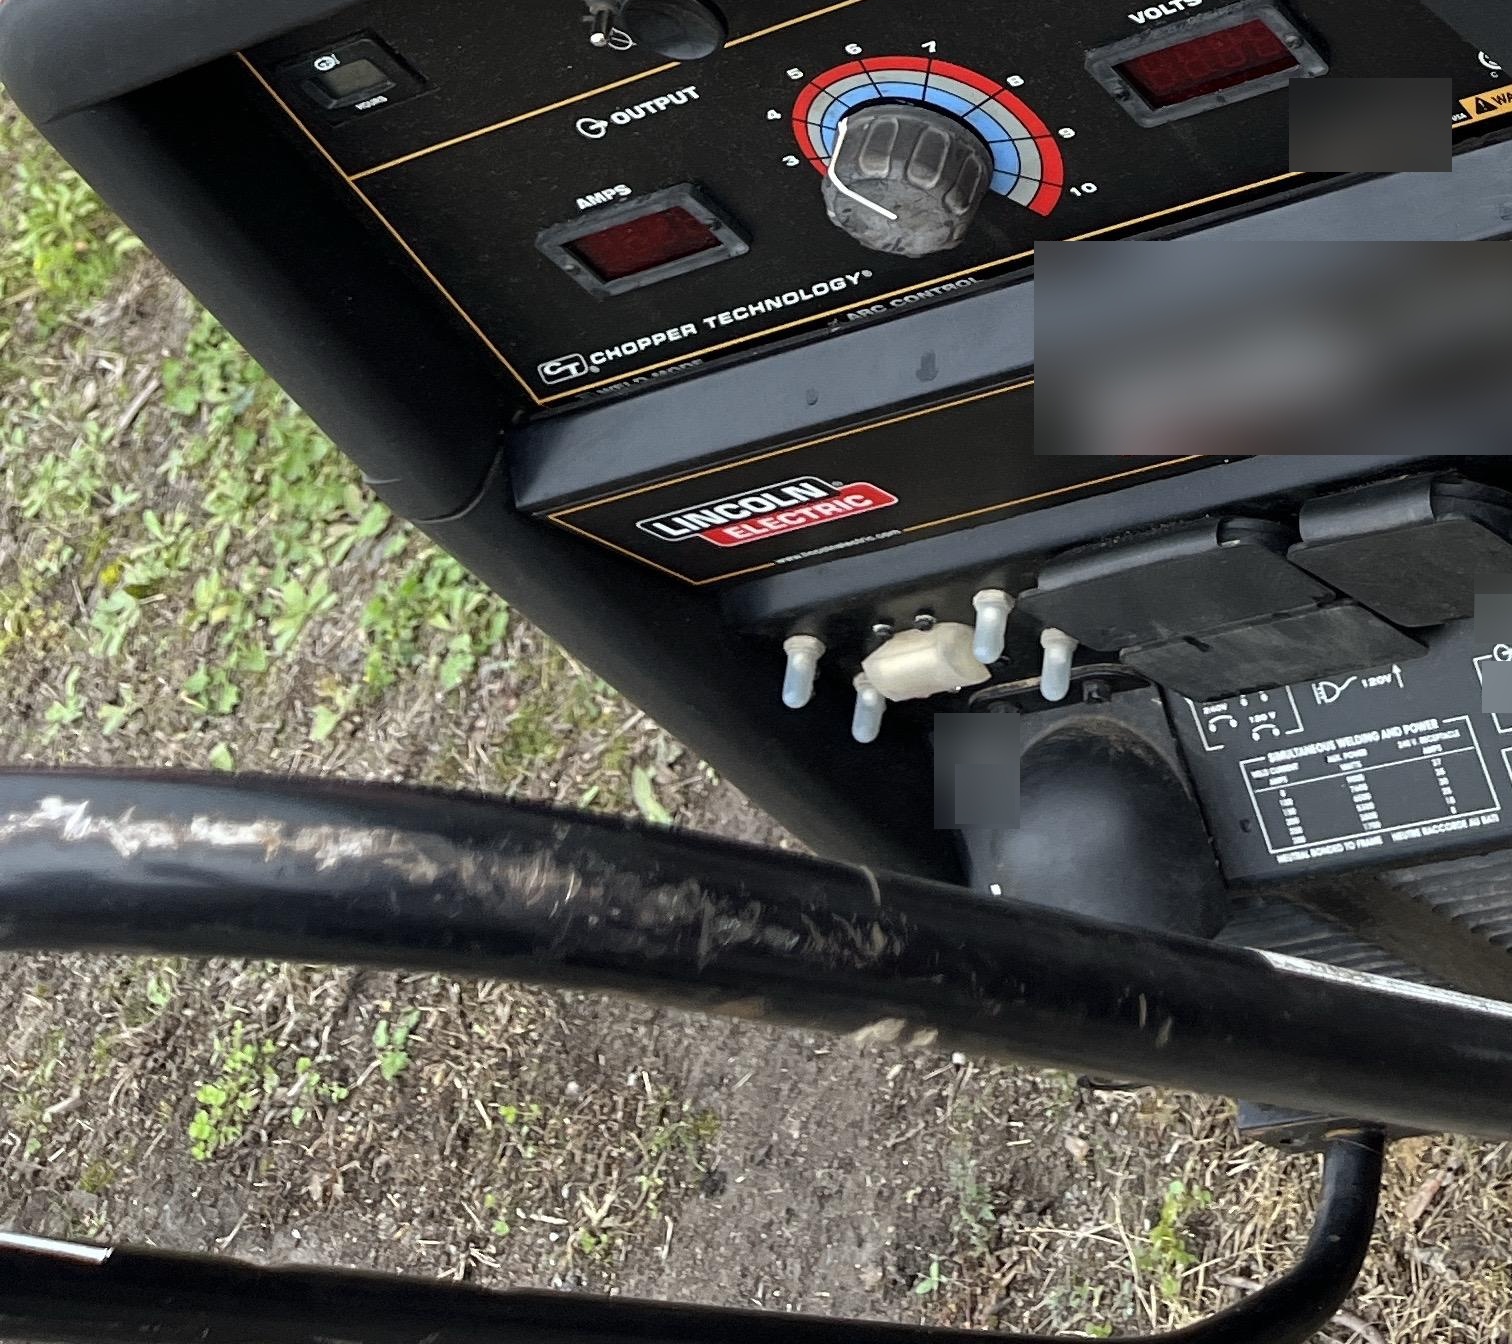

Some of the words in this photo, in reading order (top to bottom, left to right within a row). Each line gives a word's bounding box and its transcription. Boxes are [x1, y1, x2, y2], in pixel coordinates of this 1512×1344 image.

[844, 42, 863, 56] 6
[920, 39, 938, 54] 7
[786, 67, 805, 80] 5
[1005, 74, 1025, 88] 8
[609, 84, 702, 126] OUTPUT
[766, 108, 783, 121] 4
[1057, 126, 1076, 139] 9
[781, 154, 800, 167] 3
[574, 183, 633, 211] AMPS
[1069, 180, 1098, 198] 10
[844, 302, 888, 323] ARC
[888, 276, 983, 308] CONTROL
[589, 323, 698, 365] CHOPPER
[702, 271, 861, 330] TECHNOLOGY
[652, 481, 829, 536] LINCOLN
[722, 493, 874, 540] ELECTRIC
